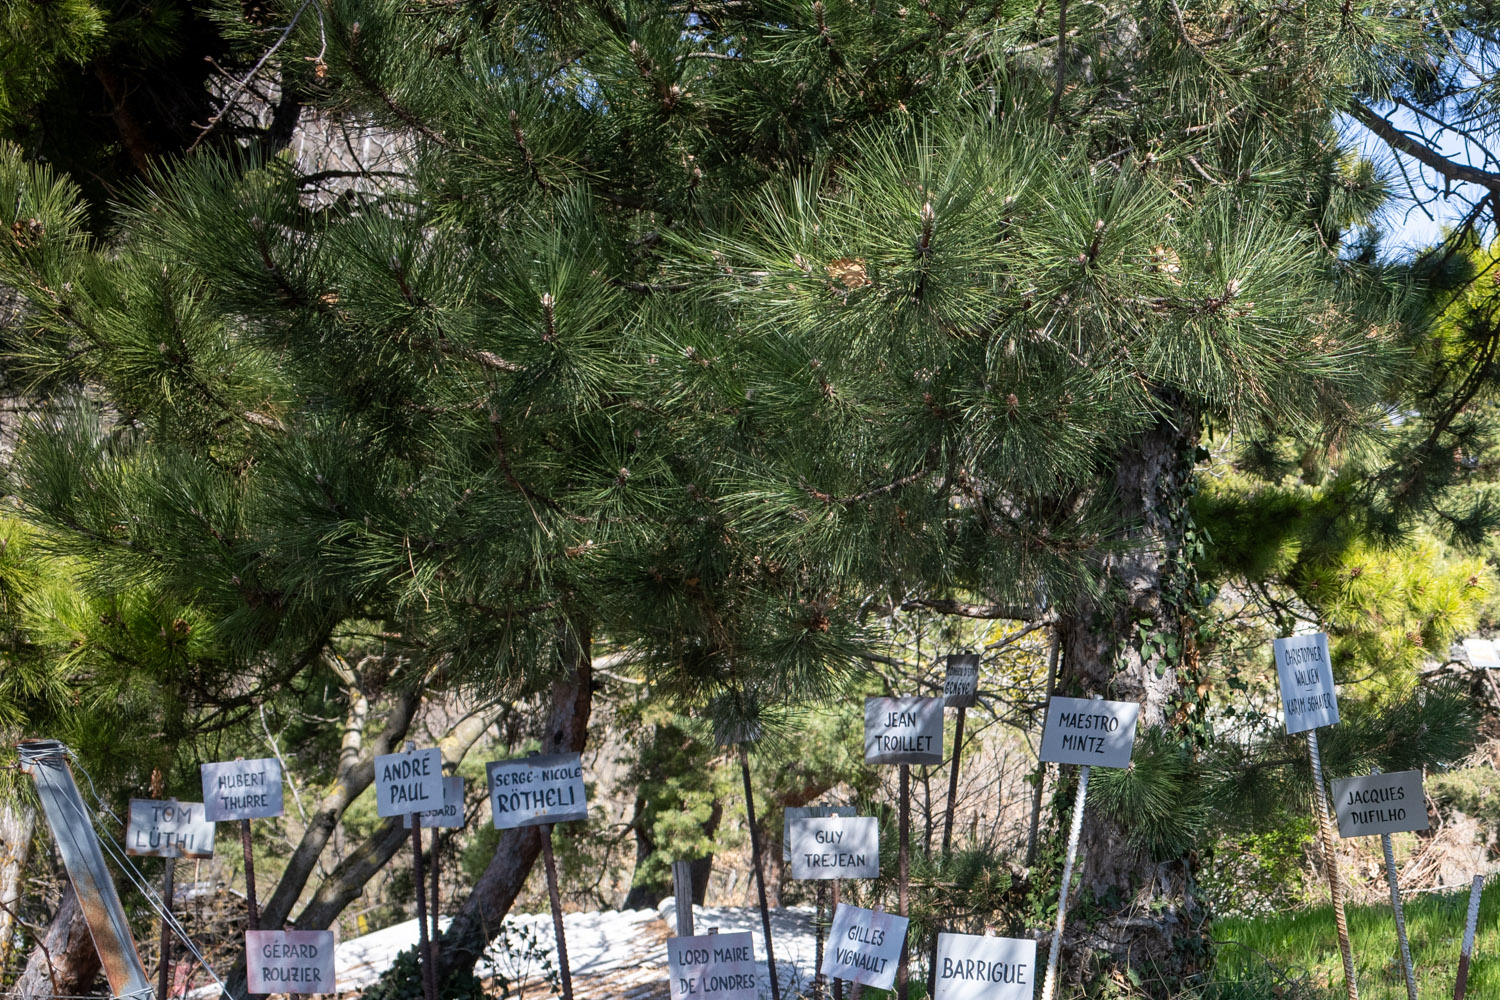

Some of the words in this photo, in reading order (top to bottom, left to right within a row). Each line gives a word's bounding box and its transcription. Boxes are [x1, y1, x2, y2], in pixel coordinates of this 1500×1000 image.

[1285, 646, 1324, 666] CHRISTOPHER
[1294, 668, 1320, 687] WALKEN
[884, 712, 916, 728] JEAN
[1059, 713, 1119, 733] MAESTRO
[875, 735, 933, 752] TROILLET
[1062, 735, 1106, 754] MINTZ
[382, 752, 431, 783] ANDRÉ
[218, 771, 266, 790] HUBERT
[222, 794, 269, 810] THURRE
[390, 782, 429, 804] PAUL
[496, 785, 576, 814] RÖTHELI
[1347, 786, 1405, 805] JACQUES
[151, 806, 192, 824] TOM
[1351, 808, 1407, 825] DUFILHO
[136, 826, 195, 850] LÜTHI
[814, 830, 844, 845] GUY
[804, 853, 866, 868] TREJEAN
[847, 925, 885, 947] GILLES
[263, 939, 319, 960] GÉRARD
[679, 949, 710, 966] LORD
[713, 946, 750, 963] MAIRE
[835, 947, 888, 975] VIGNAULT
[262, 966, 322, 983] ROUZIER
[941, 957, 1027, 985] BARRIGUE
[680, 977, 697, 995] DE
[703, 974, 756, 993] LONDRES
